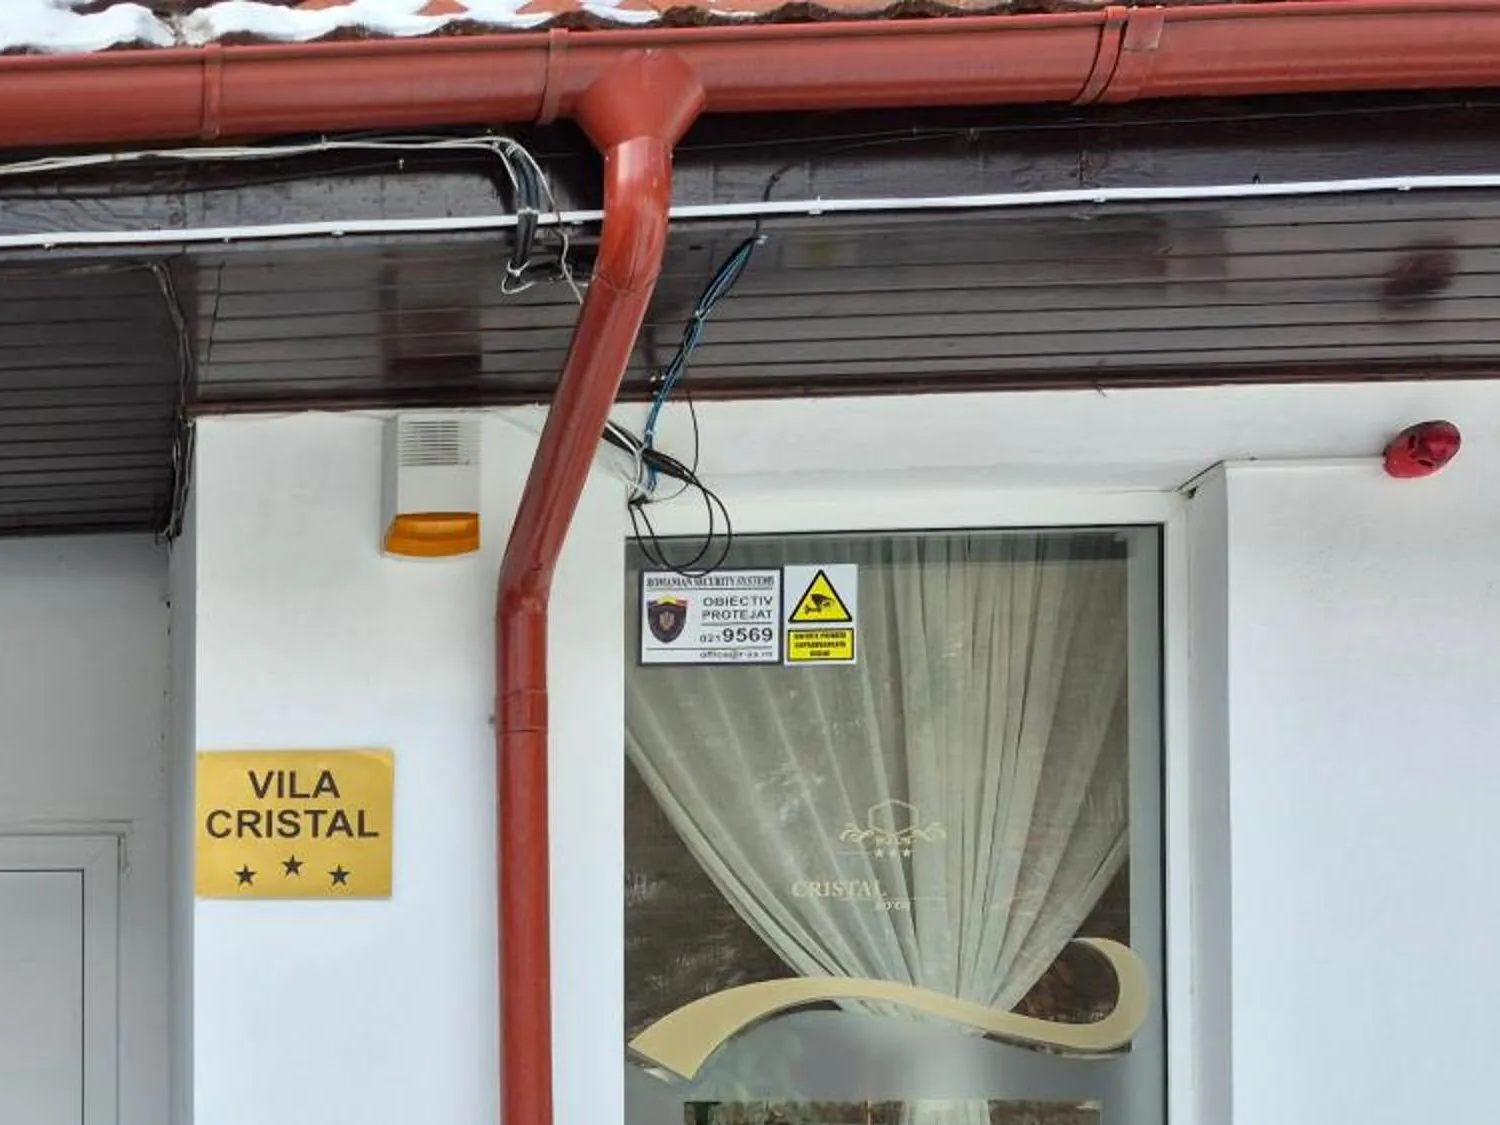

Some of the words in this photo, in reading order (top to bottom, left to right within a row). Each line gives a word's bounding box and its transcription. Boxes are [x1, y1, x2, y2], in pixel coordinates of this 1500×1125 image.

[702, 596, 774, 607] OBIECTIV
[702, 609, 773, 620] PROTEJAT
[247, 769, 341, 799] VILA
[205, 809, 381, 839] CRISTAL
[791, 878, 887, 898] CRISTAL
